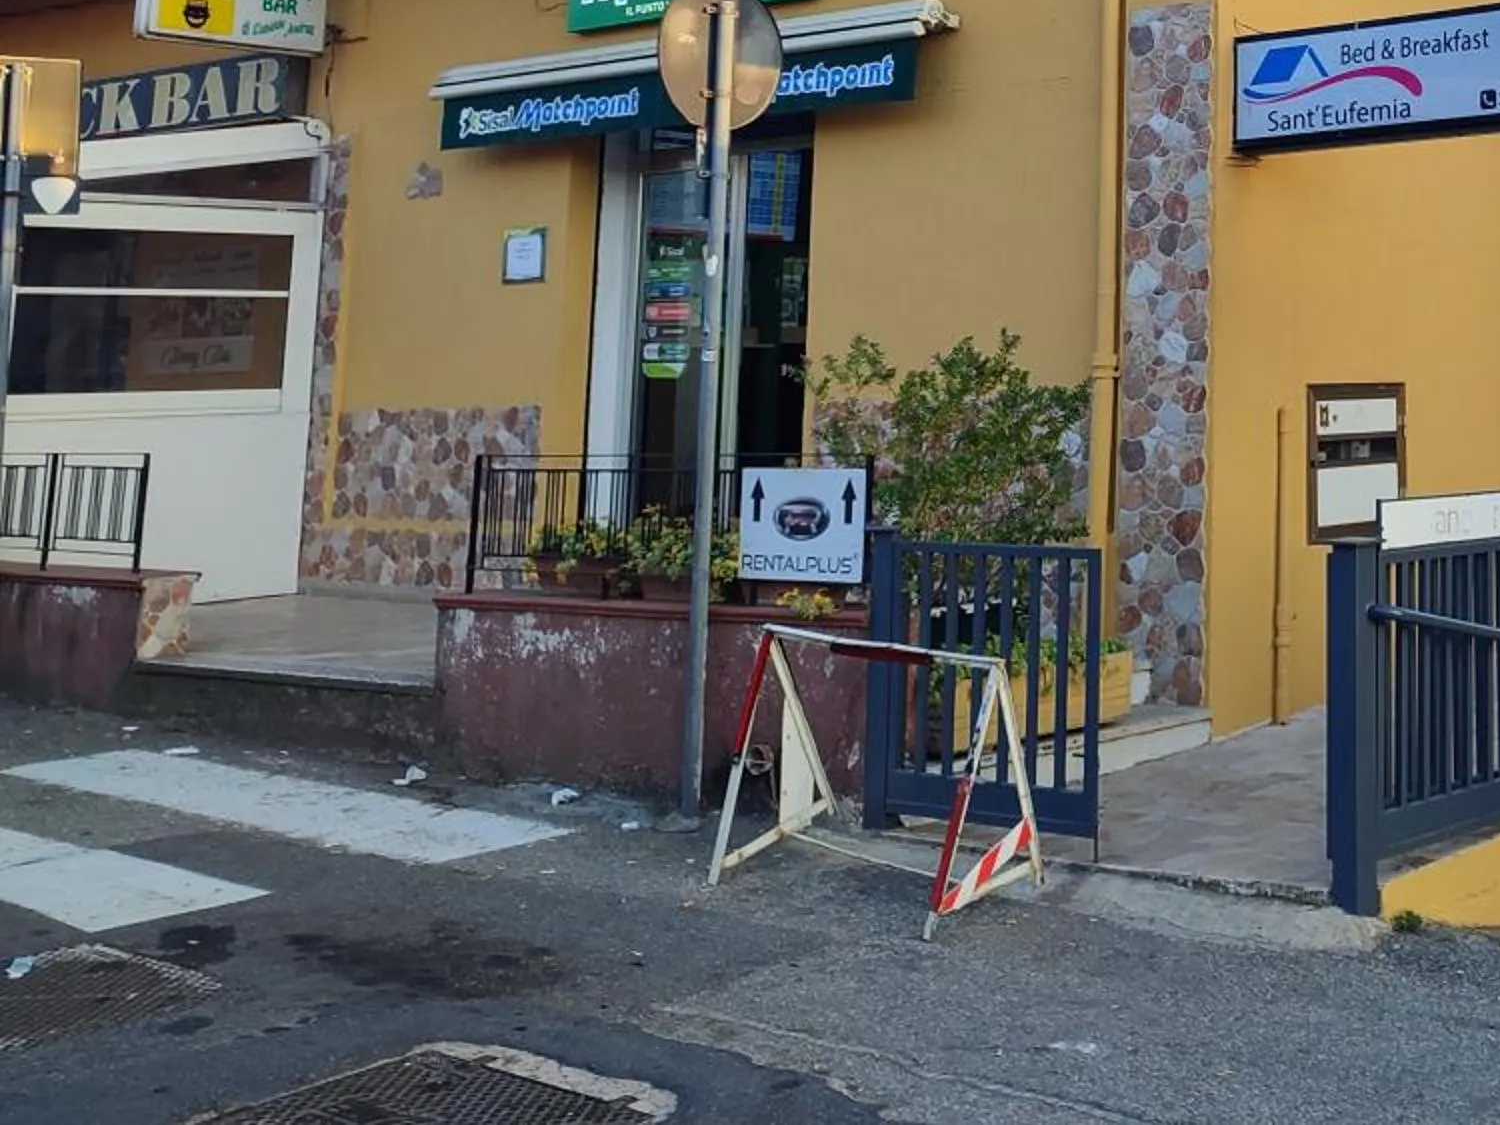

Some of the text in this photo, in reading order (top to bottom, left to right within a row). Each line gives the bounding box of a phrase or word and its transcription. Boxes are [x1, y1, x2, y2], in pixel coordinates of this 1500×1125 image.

[1340, 27, 1491, 66] Bed & Breakfast
[151, 57, 281, 126] BAR
[772, 52, 895, 102] atchpoint
[479, 87, 640, 134] Sisal Matchpoint
[1267, 98, 1412, 133] Sant'Eufemia
[741, 553, 853, 575] RENTALPLUS
